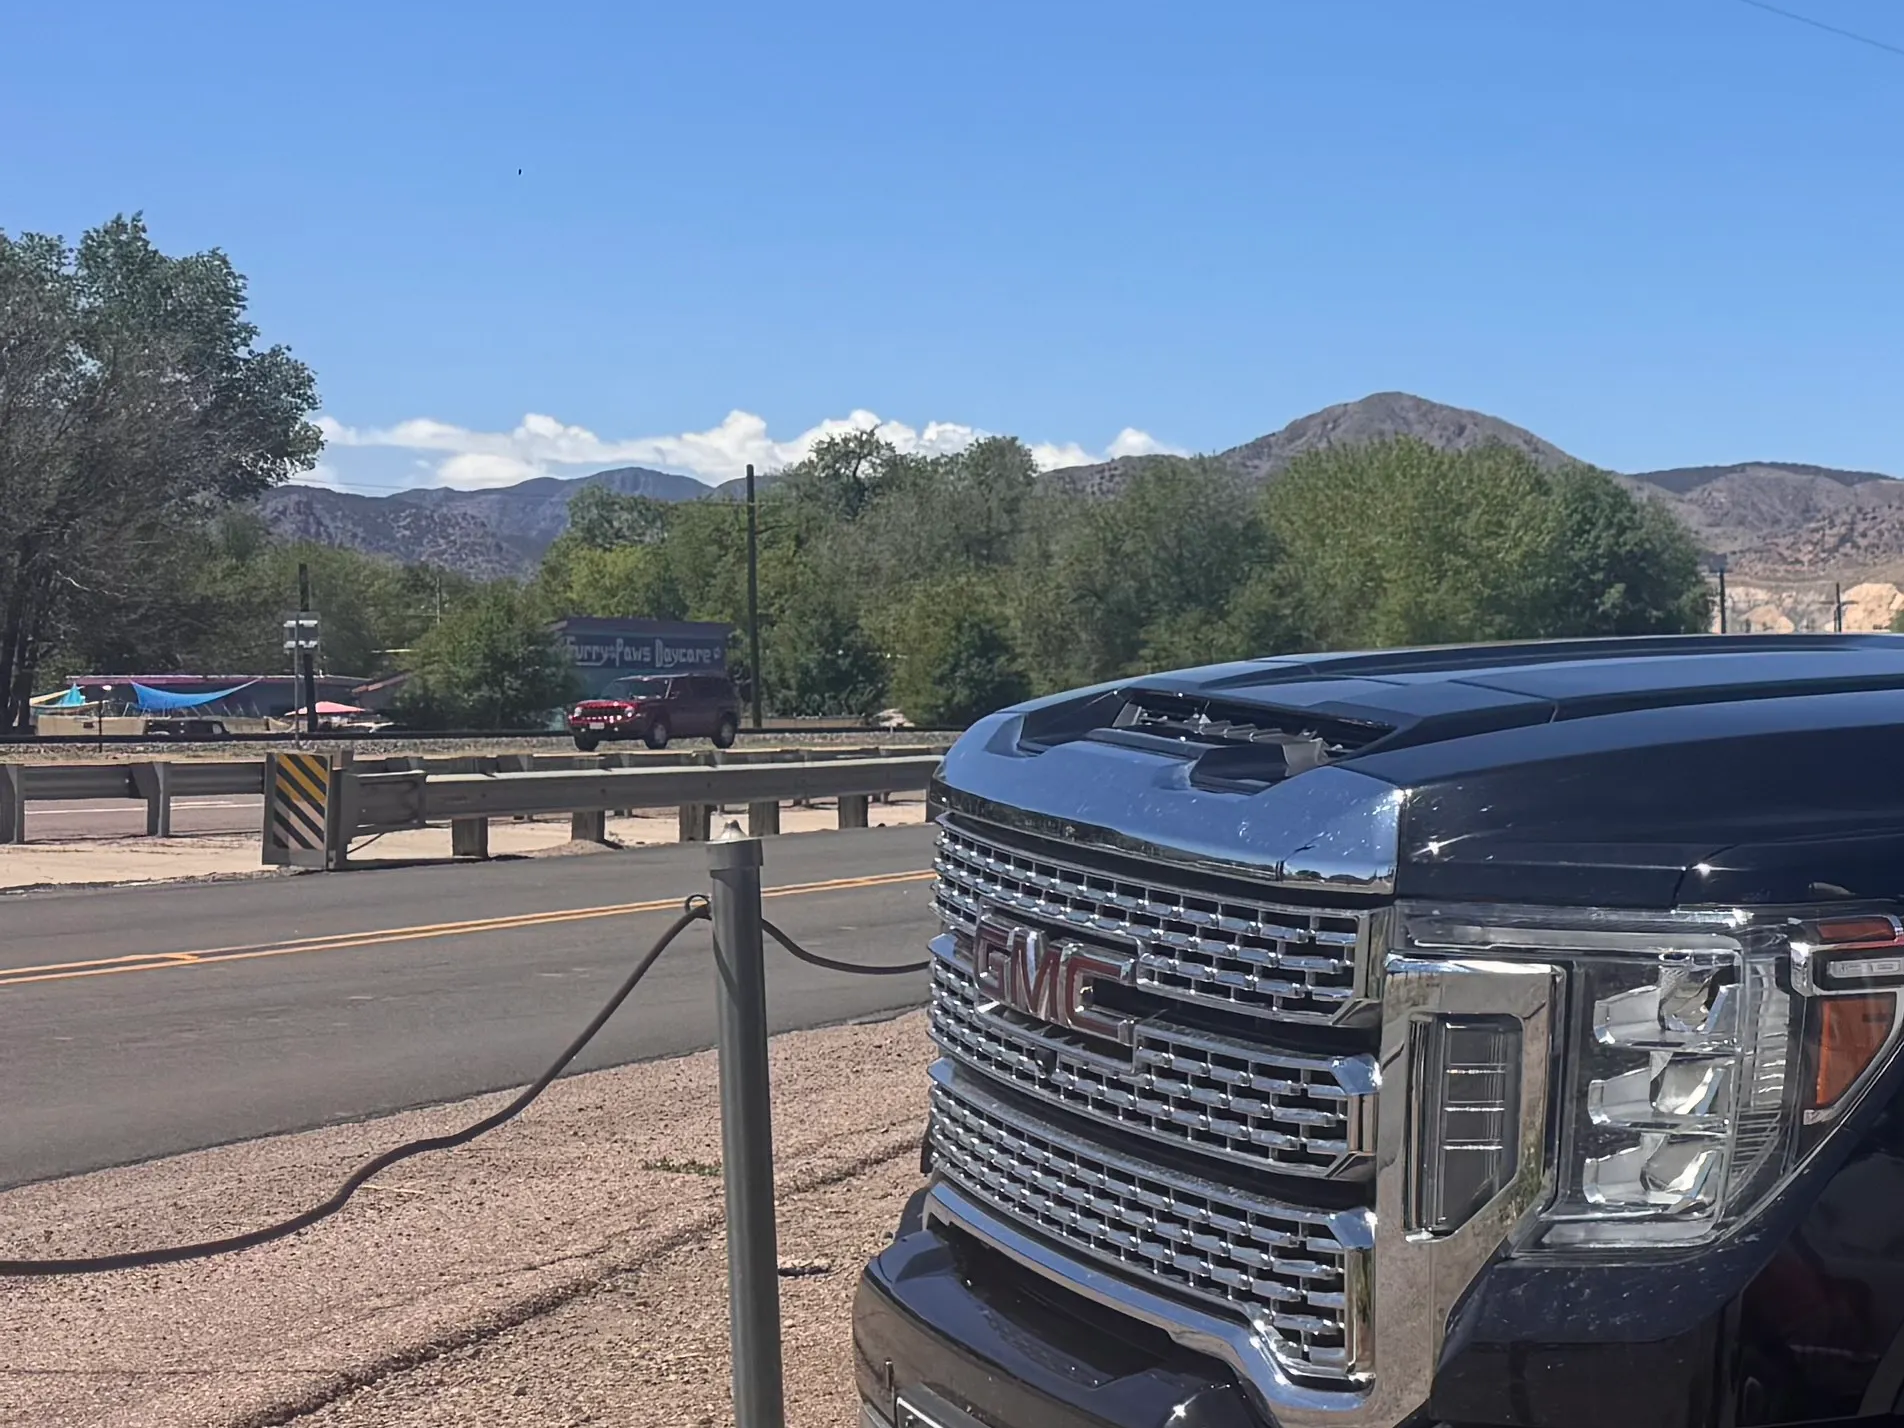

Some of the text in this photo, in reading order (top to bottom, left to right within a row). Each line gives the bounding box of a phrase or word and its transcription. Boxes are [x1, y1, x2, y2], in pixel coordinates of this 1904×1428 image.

[616, 638, 651, 667] Paws
[655, 638, 711, 668] Daycare
[976, 921, 1137, 1047] GMC
